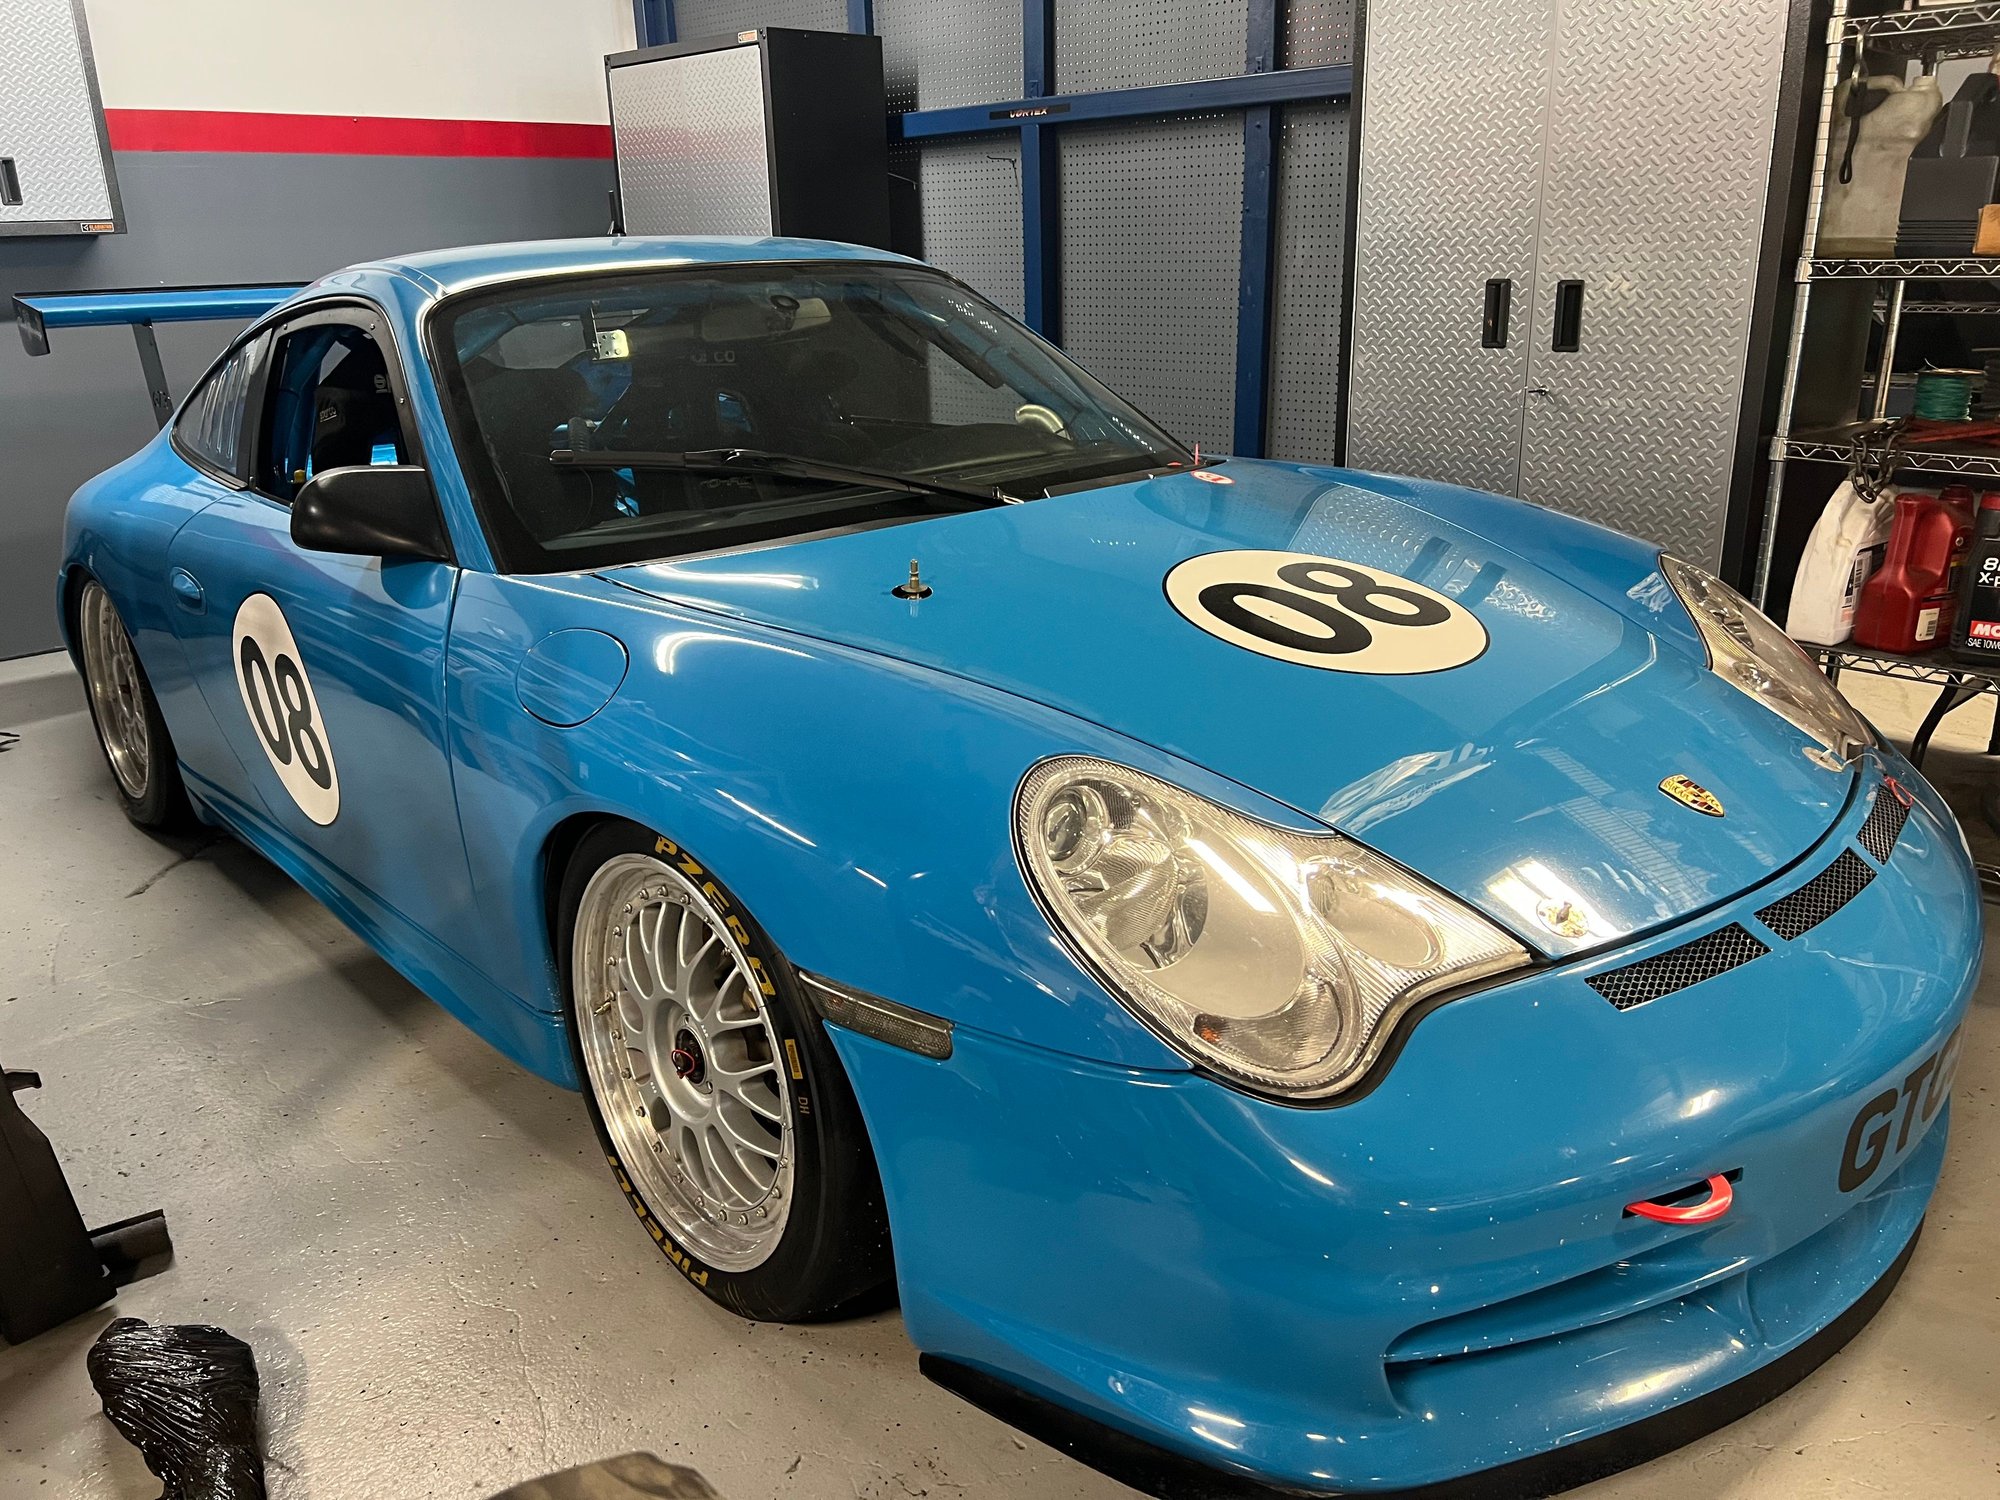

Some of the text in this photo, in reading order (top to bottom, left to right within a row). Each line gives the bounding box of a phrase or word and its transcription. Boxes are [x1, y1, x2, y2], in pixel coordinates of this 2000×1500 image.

[1009, 108, 1048, 118] VORTEX
[1198, 563, 1451, 654] 08
[1967, 637, 1982, 648] SAE
[240, 635, 332, 790] 08
[606, 1155, 708, 1286] PIRELLI
